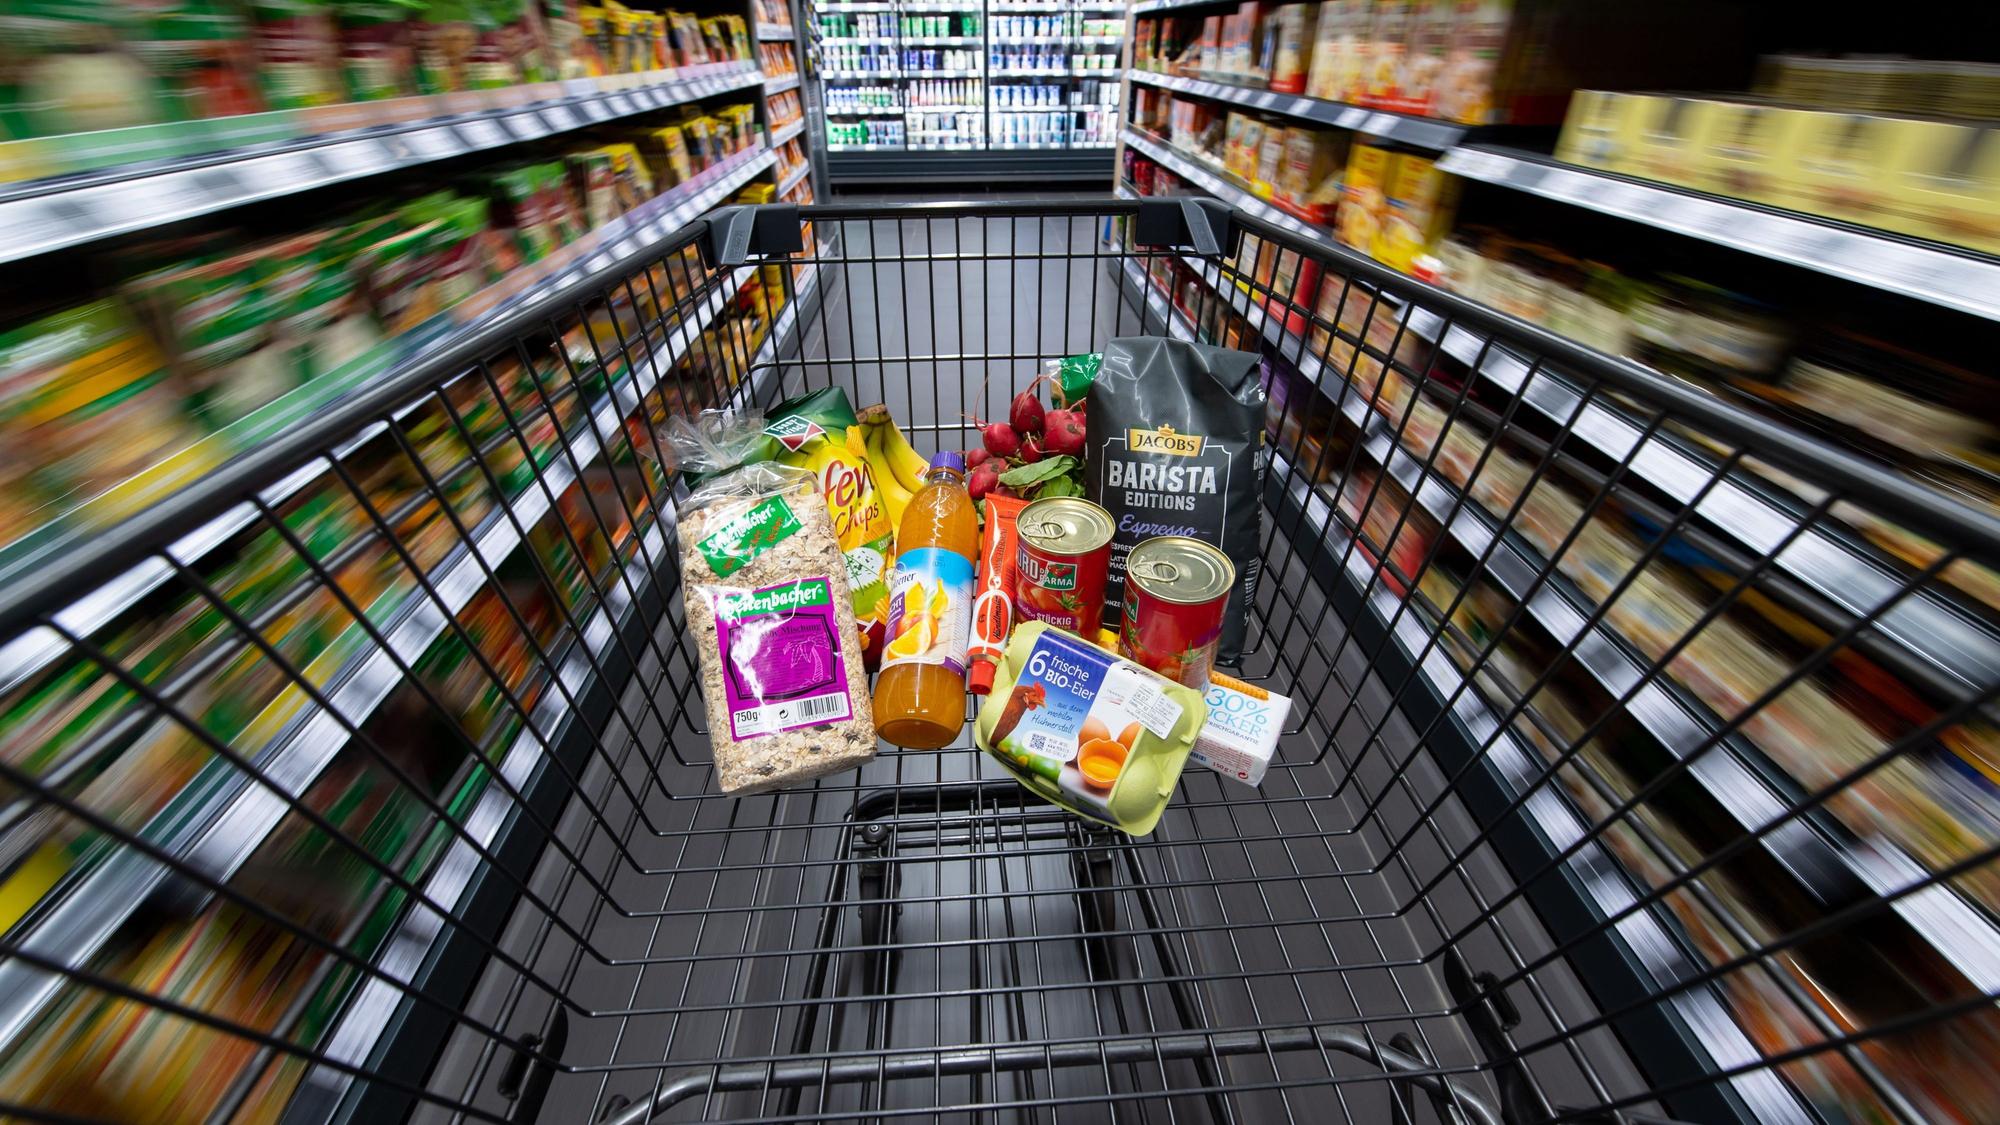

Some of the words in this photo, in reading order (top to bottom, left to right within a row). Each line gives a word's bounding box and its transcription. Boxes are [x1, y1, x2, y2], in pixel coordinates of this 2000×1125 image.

[1134, 434, 1196, 452] JACOBS
[1108, 460, 1217, 494] BARISTA
[1125, 491, 1196, 511] EDITIONS
[834, 502, 880, 539] Chips
[1118, 513, 1198, 540] Espresso
[1039, 575, 1073, 587] PARMA
[1036, 612, 1072, 626] STÜCKIG
[1029, 649, 1051, 677] 6
[1051, 655, 1090, 682] frische
[1045, 668, 1095, 701] BIO-Eier
[735, 710, 758, 723] 750g
[1205, 688, 1271, 725] 30%
